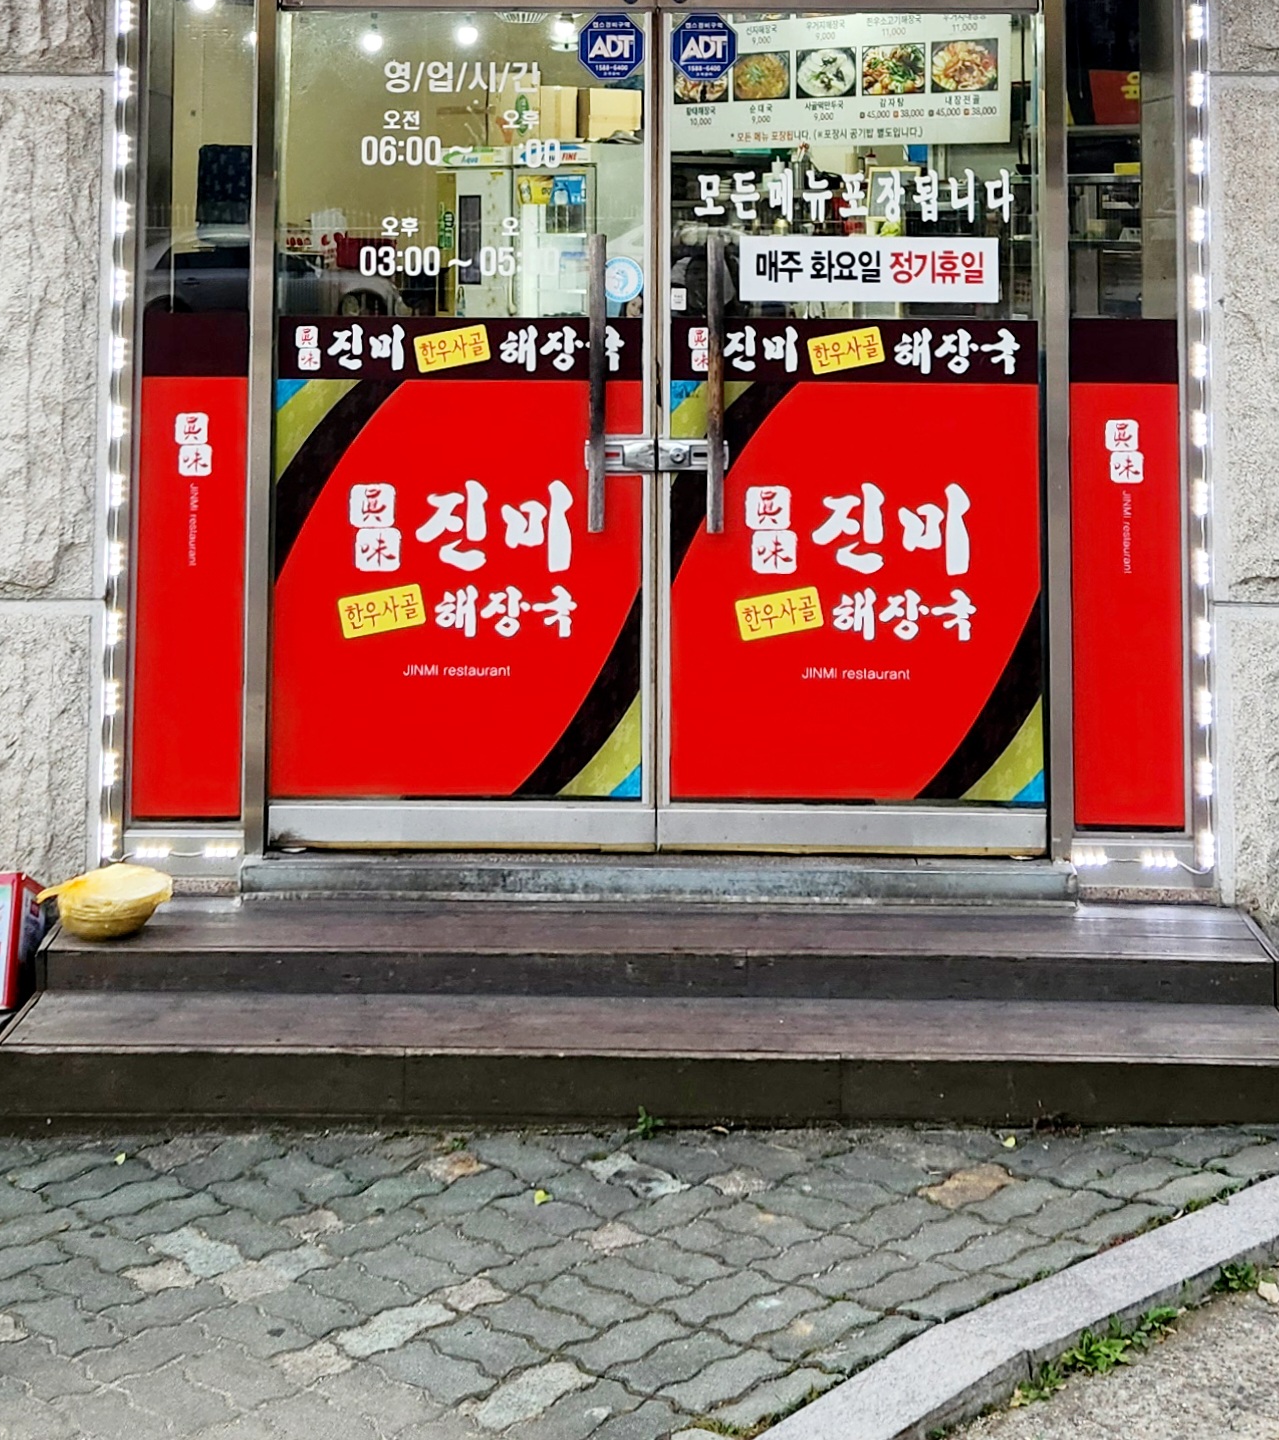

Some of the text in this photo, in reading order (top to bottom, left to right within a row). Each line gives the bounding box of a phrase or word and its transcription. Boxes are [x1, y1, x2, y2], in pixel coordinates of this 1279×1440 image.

[588, 34, 634, 58] ADT
[680, 35, 727, 62] ADT
[383, 110, 539, 130] 오전 오후
[361, 136, 441, 166] 06:00
[381, 216, 419, 237] 오후
[359, 246, 440, 276] 03:00
[756, 250, 985, 284] 매주 화요일 정기휴일
[327, 323, 406, 371] 진미
[420, 332, 486, 366] 한우사골
[723, 325, 1020, 375] 진미 한우사골 해장국
[415, 479, 574, 573] 진미
[812, 482, 971, 576] 진미
[343, 585, 578, 638] 한우사골 해장국
[741, 588, 977, 641] 한우사골 해장국
[402, 663, 511, 677] JINMI restaurant
[801, 666, 911, 681] JINMI restaurant
